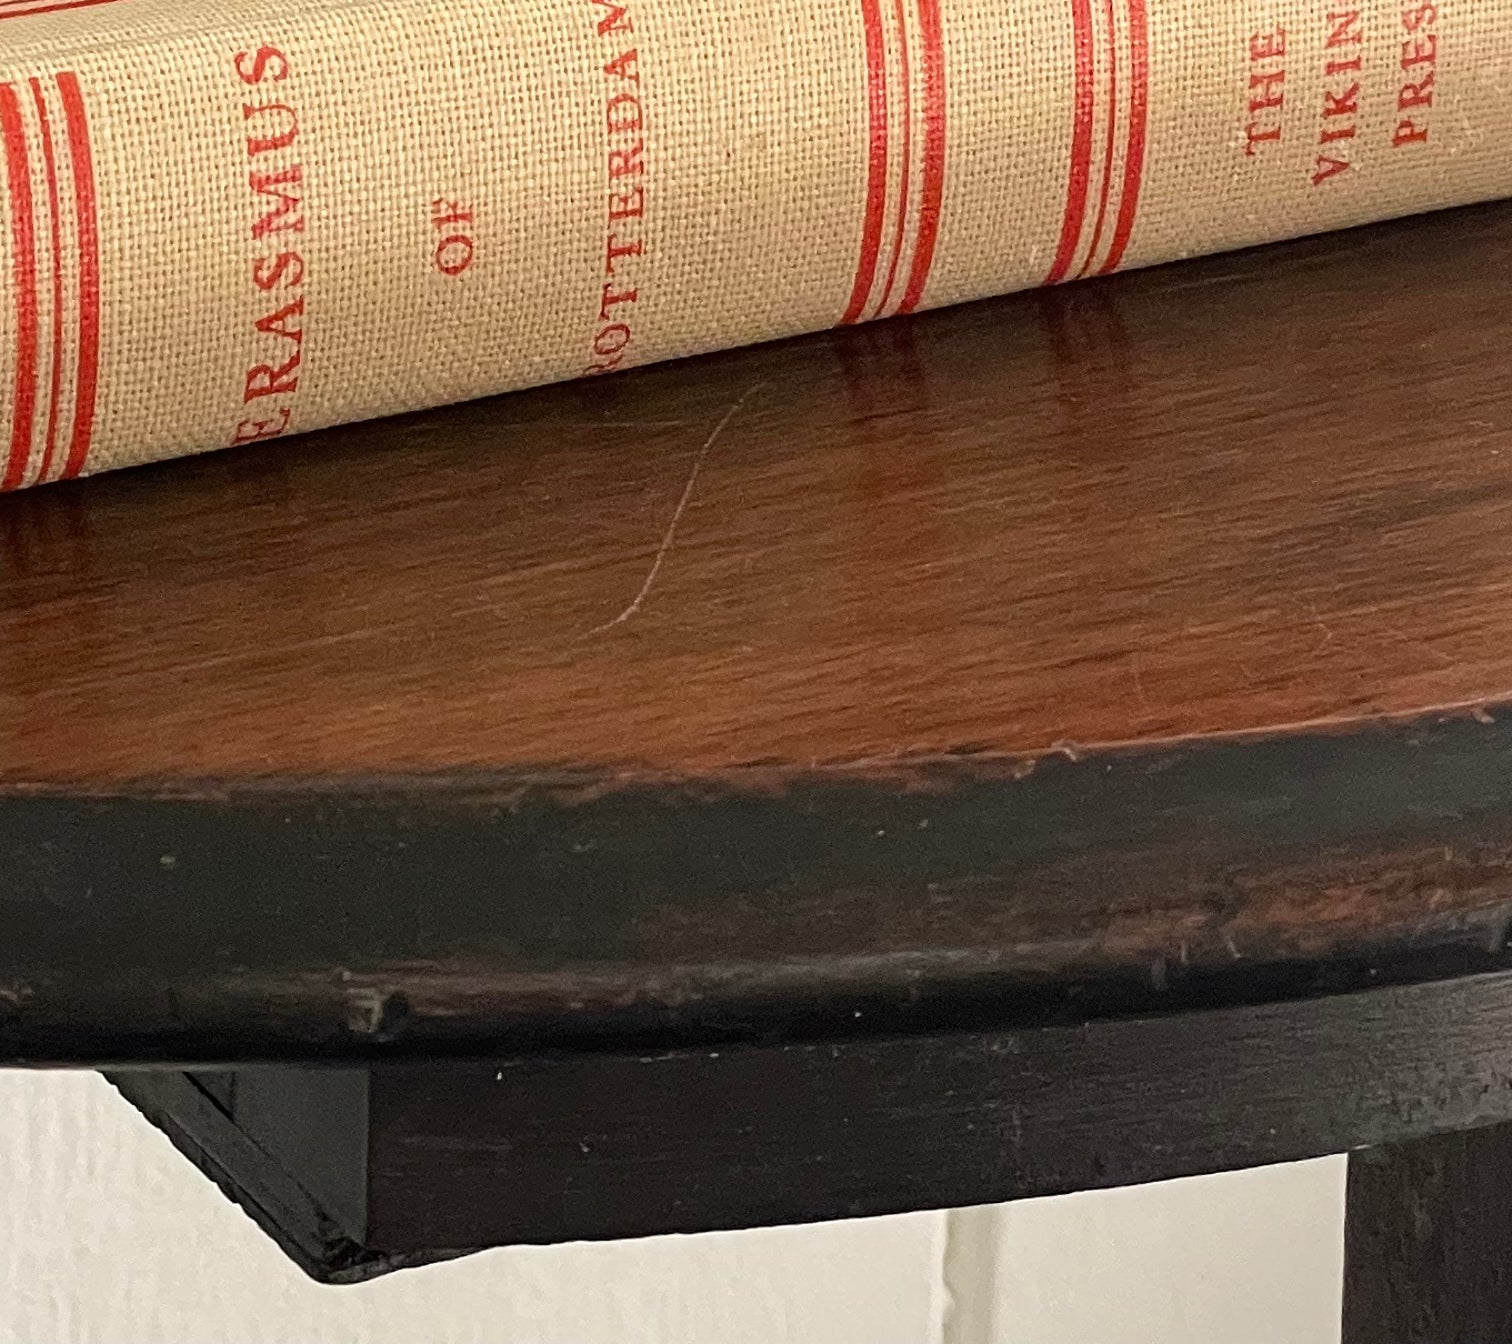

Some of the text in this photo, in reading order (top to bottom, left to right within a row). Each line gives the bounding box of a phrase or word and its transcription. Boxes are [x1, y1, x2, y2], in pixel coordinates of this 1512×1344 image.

[1244, 23, 1287, 156] THE
[231, 42, 305, 446] ERASMUS
[431, 197, 474, 277] OF
